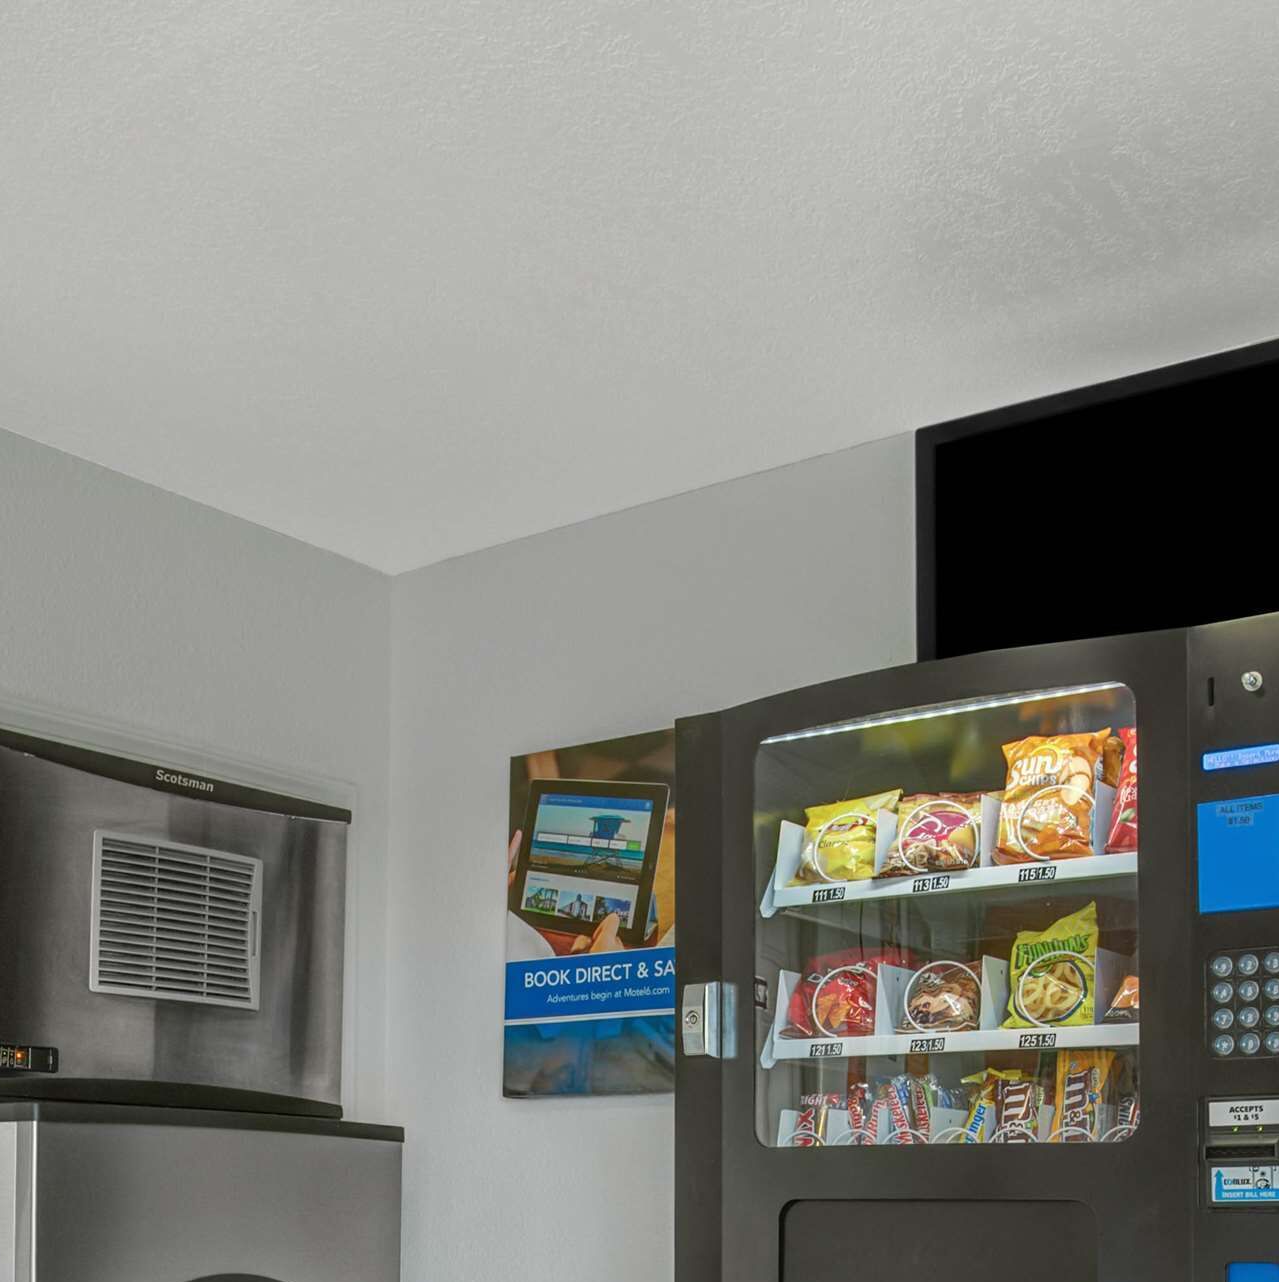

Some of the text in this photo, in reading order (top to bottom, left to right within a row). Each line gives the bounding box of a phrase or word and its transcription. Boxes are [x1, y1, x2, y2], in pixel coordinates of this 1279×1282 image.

[156, 769, 214, 792] Scotsman
[1020, 867, 1055, 881] 115 1.50
[914, 877, 949, 891] 113 1.50
[814, 888, 845, 902] 111 1.50
[524, 959, 675, 988] BOOK DIRECT & SA
[546, 986, 670, 1004] Adventures begin at Motel6.com
[911, 1039, 944, 1051] 123 1.50
[1020, 1034, 1055, 1046] 125 1.50
[811, 1044, 842, 1056] 121 1.50
[1229, 1105, 1264, 1113] ACCEPTS
